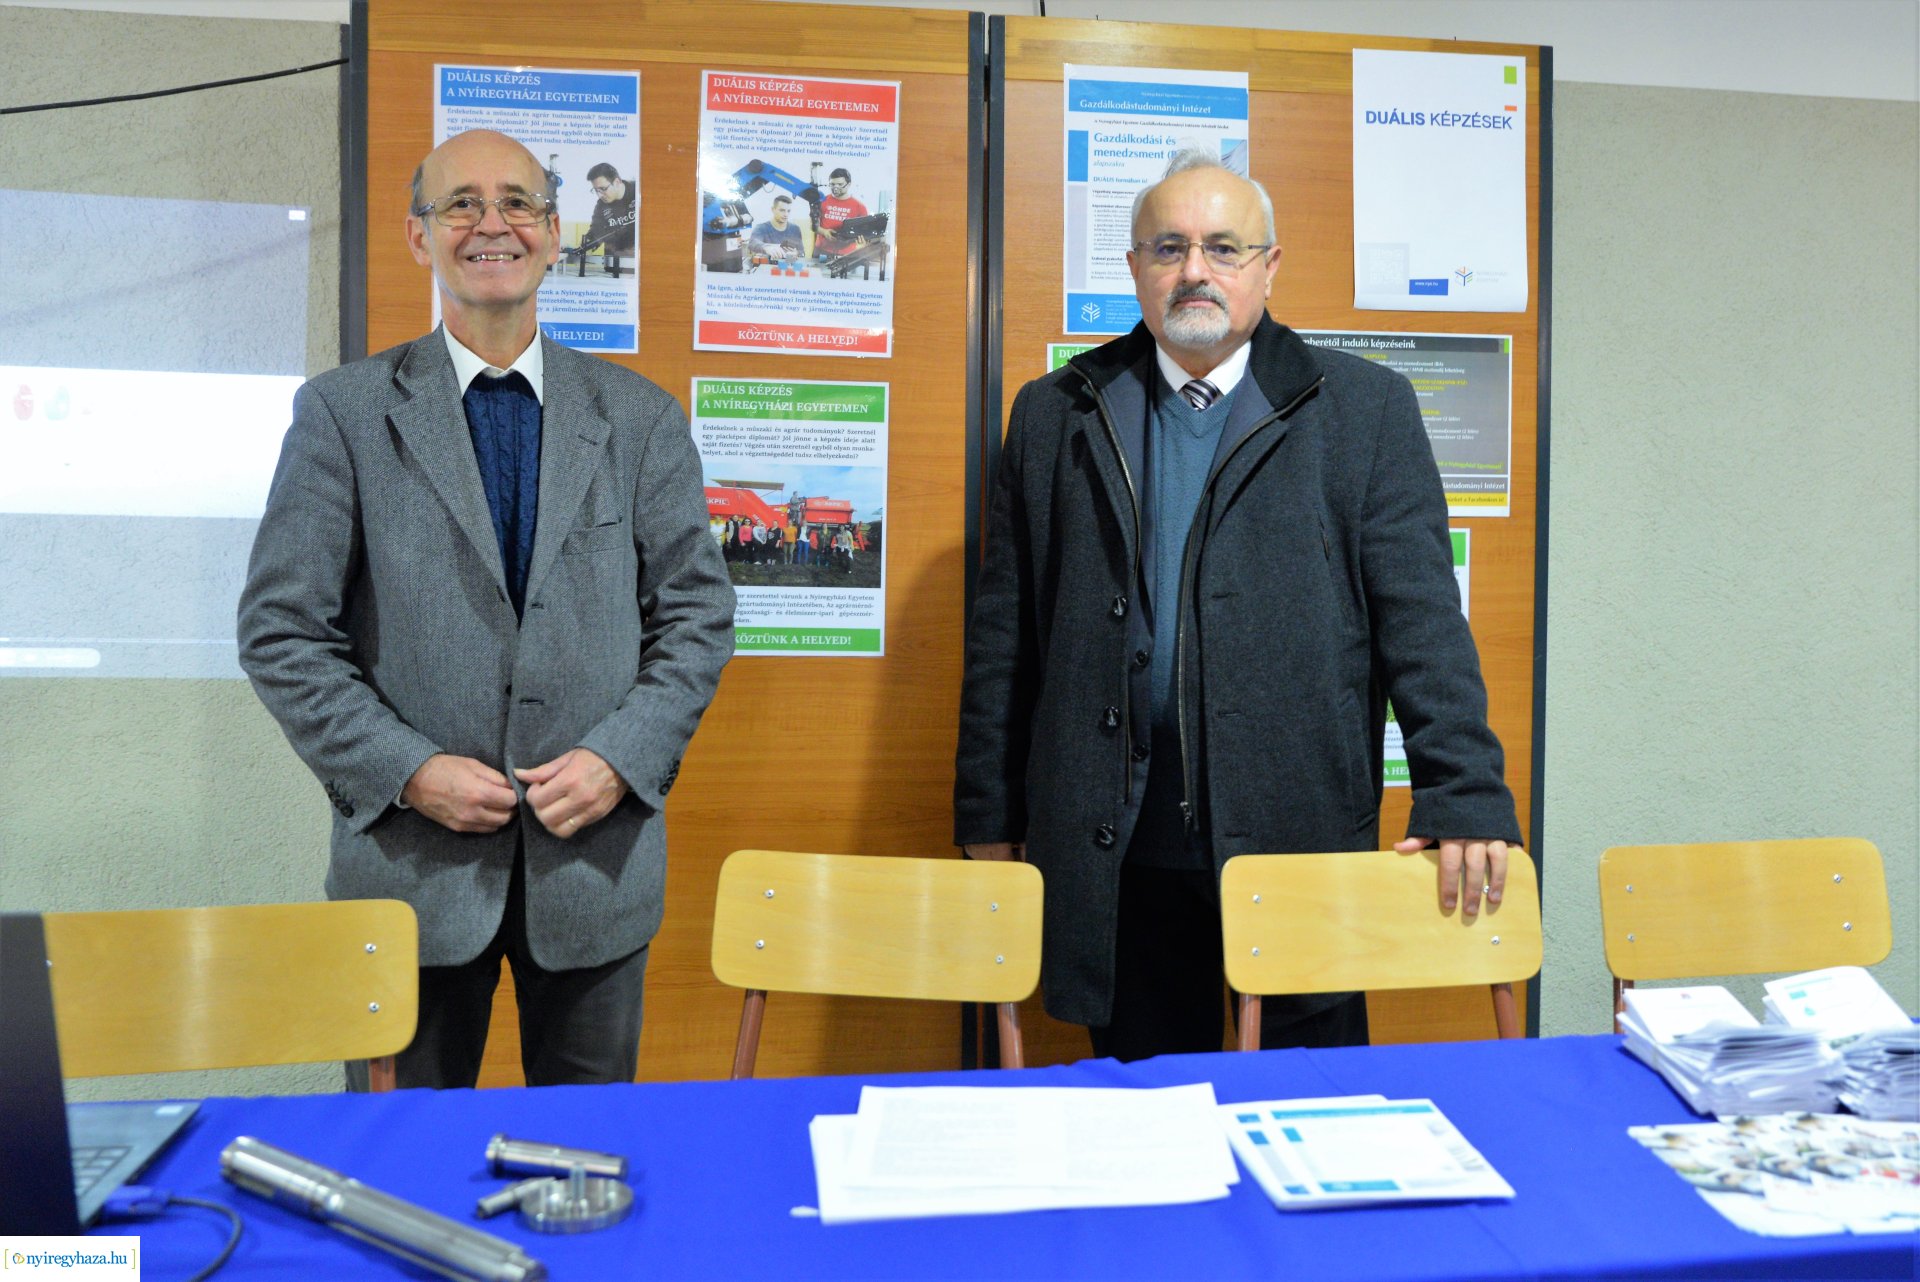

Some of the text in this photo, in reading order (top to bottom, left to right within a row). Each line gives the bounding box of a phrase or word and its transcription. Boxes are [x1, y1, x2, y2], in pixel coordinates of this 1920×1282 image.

[446, 72, 540, 85] DUÁLIS KÉPZÉS
[713, 77, 804, 93] DUÁLIS KÉPZÉS
[446, 87, 620, 104] A NYÍREGYHÁZI EGYETEMEN
[712, 92, 880, 113] A NYÍREGYHÁZI EGYETEMEN
[1079, 99, 1211, 114] Gazdálkodástudományi Intézet
[1365, 108, 1512, 130] DUÁLIS KÉPZÉSEK
[1094, 132, 1176, 145] Gazdálkodási és
[1094, 148, 1164, 159] menedzsment
[553, 331, 605, 341] HELYED!
[738, 330, 858, 346] KÖZTÜNK A HELYED!
[1342, 339, 1368, 348] induló
[1370, 340, 1416, 350] képzéseink
[702, 383, 792, 396] DUÁLIS KÉPZÉS
[702, 399, 868, 413] A NYÍREGYHÁZI EGYETEMEN
[735, 632, 852, 645] KÖZTÜNK A HELYED!
